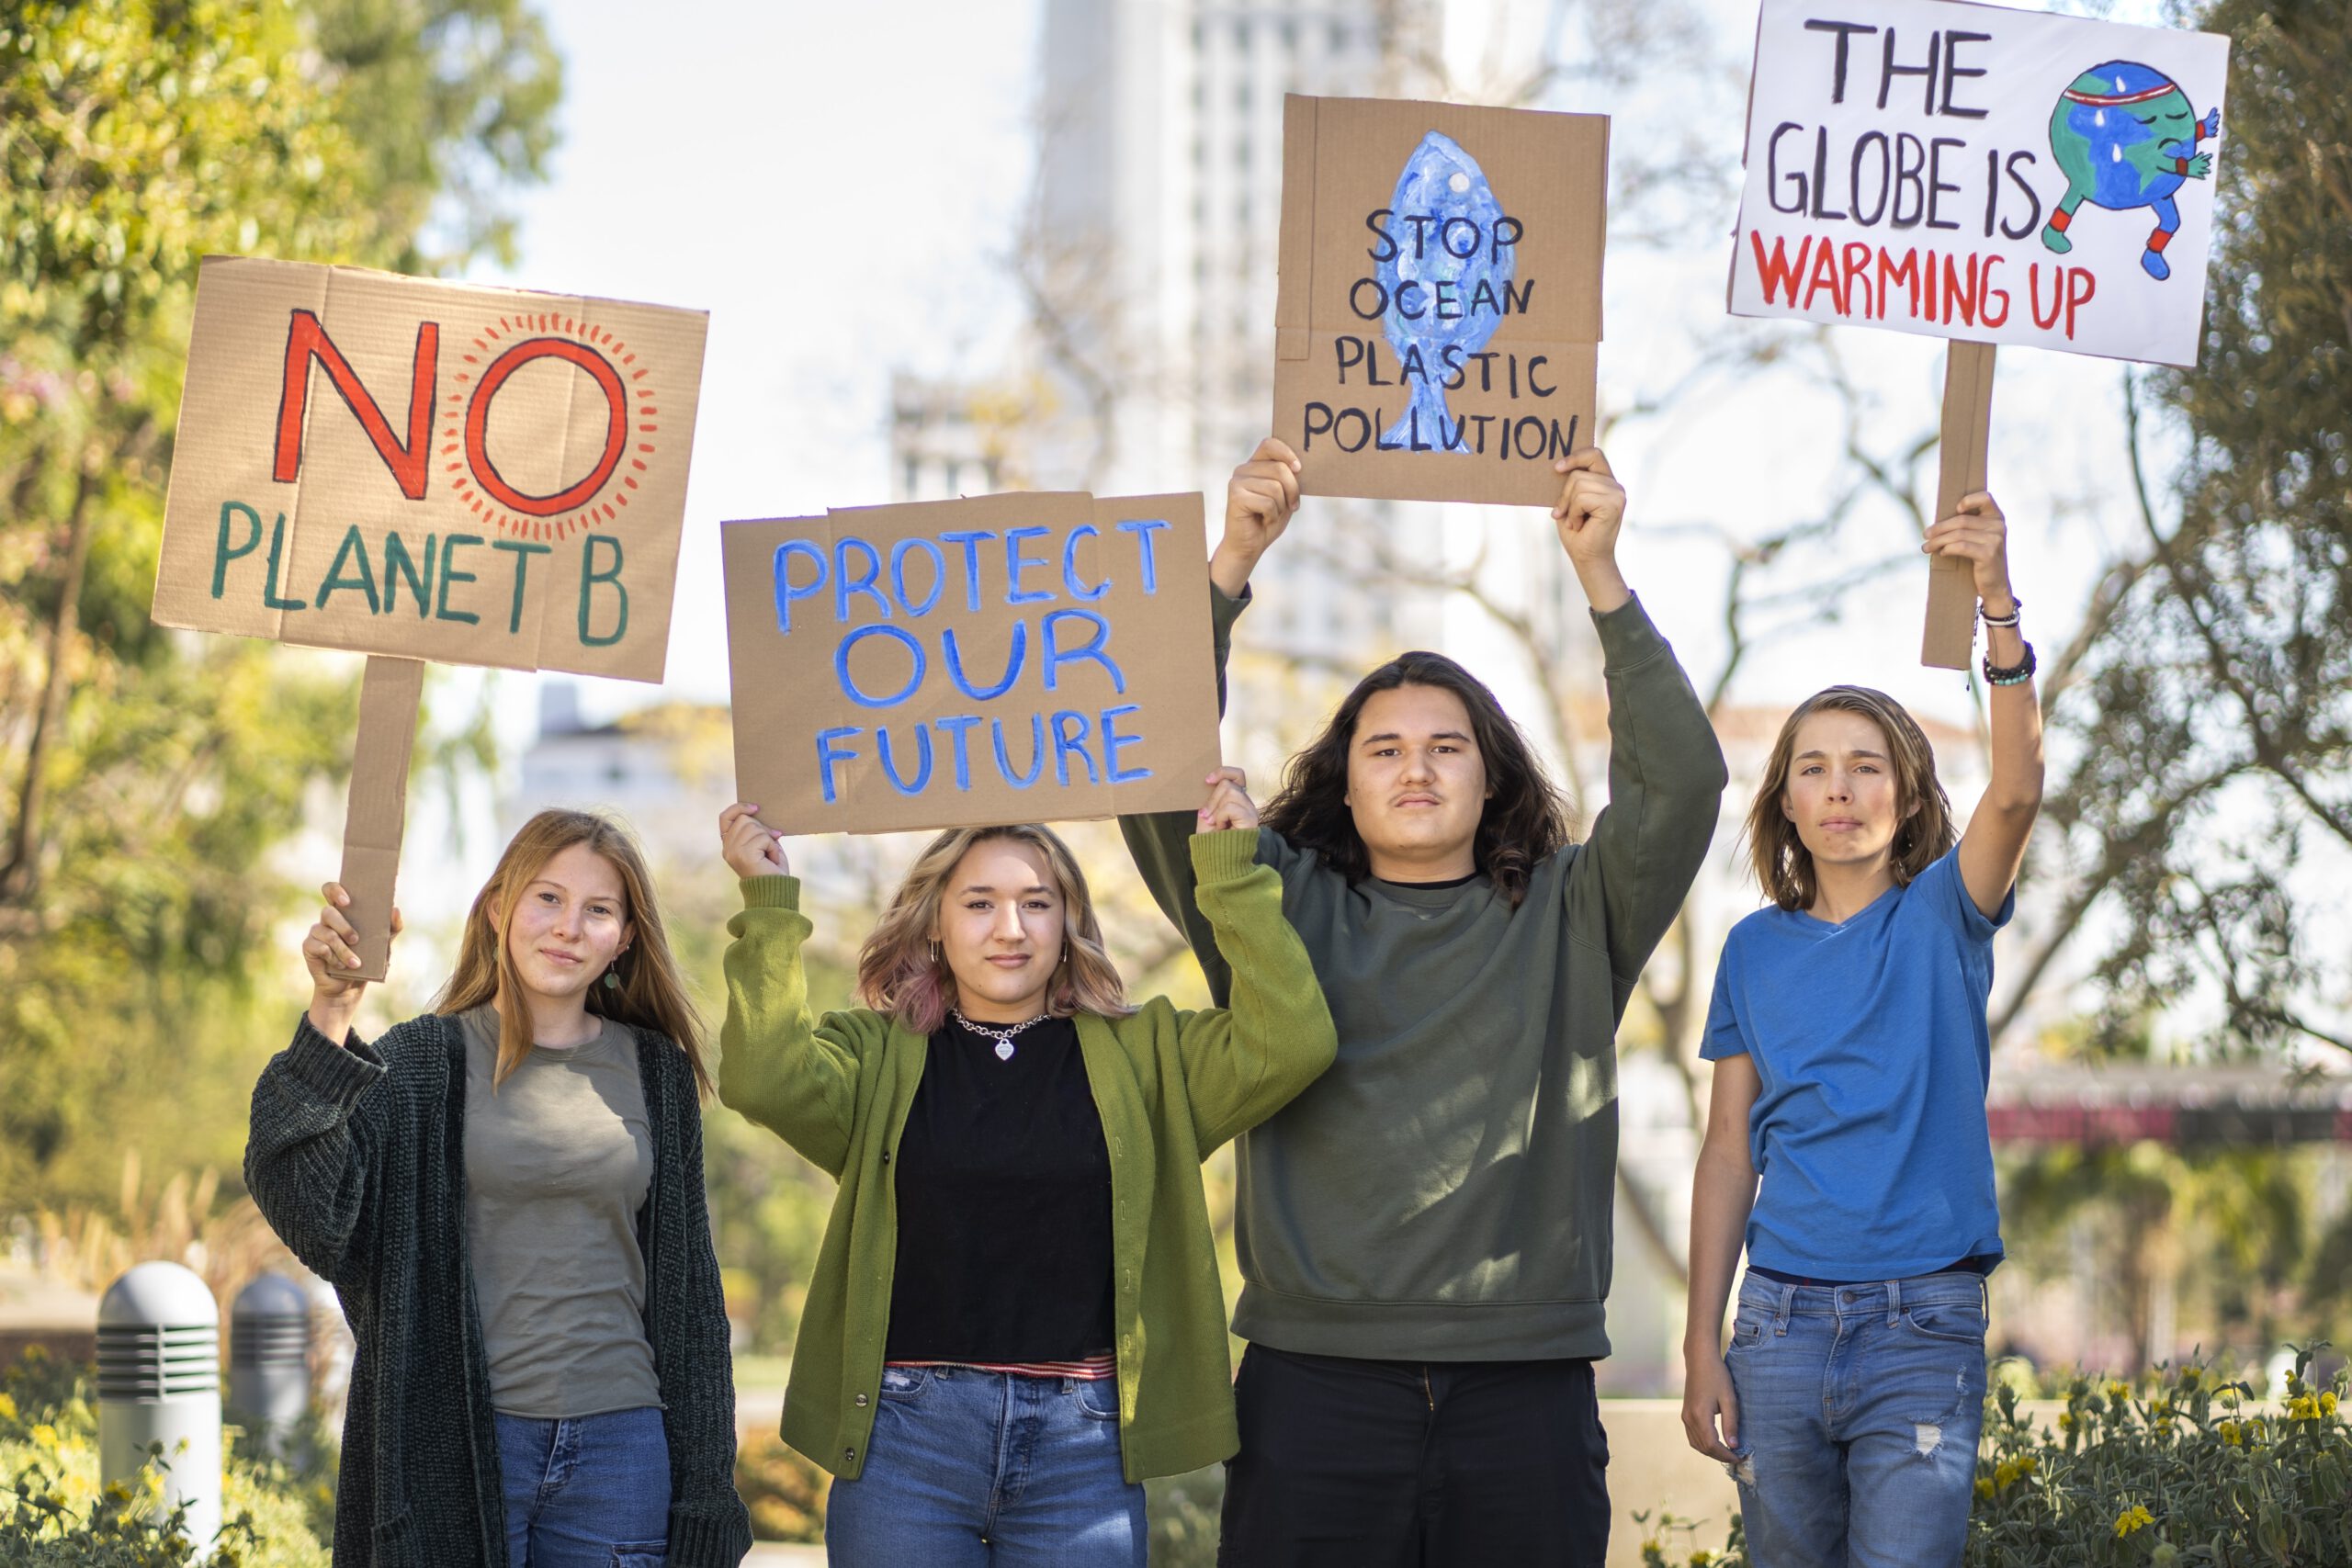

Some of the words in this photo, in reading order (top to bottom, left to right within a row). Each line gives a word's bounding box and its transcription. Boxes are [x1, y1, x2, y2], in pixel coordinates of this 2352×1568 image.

[1804, 18, 1992, 119] THE
[1767, 121, 1966, 230] GLOBE
[1984, 149, 2041, 240] IS
[1365, 209, 1523, 265] STOP
[1750, 230, 2010, 328] WARMING
[2029, 262, 2096, 341] UP
[1349, 277, 1535, 321] OCEAN
[272, 308, 628, 516] NO
[1335, 336, 1557, 399] PLASTIC
[1303, 402, 1578, 460] POLLUTION
[211, 501, 552, 634] PLANET
[578, 534, 628, 647] B
[773, 519, 1172, 636] PROTECT
[833, 608, 1126, 708] OUR
[816, 704, 1154, 804] FUTURE
